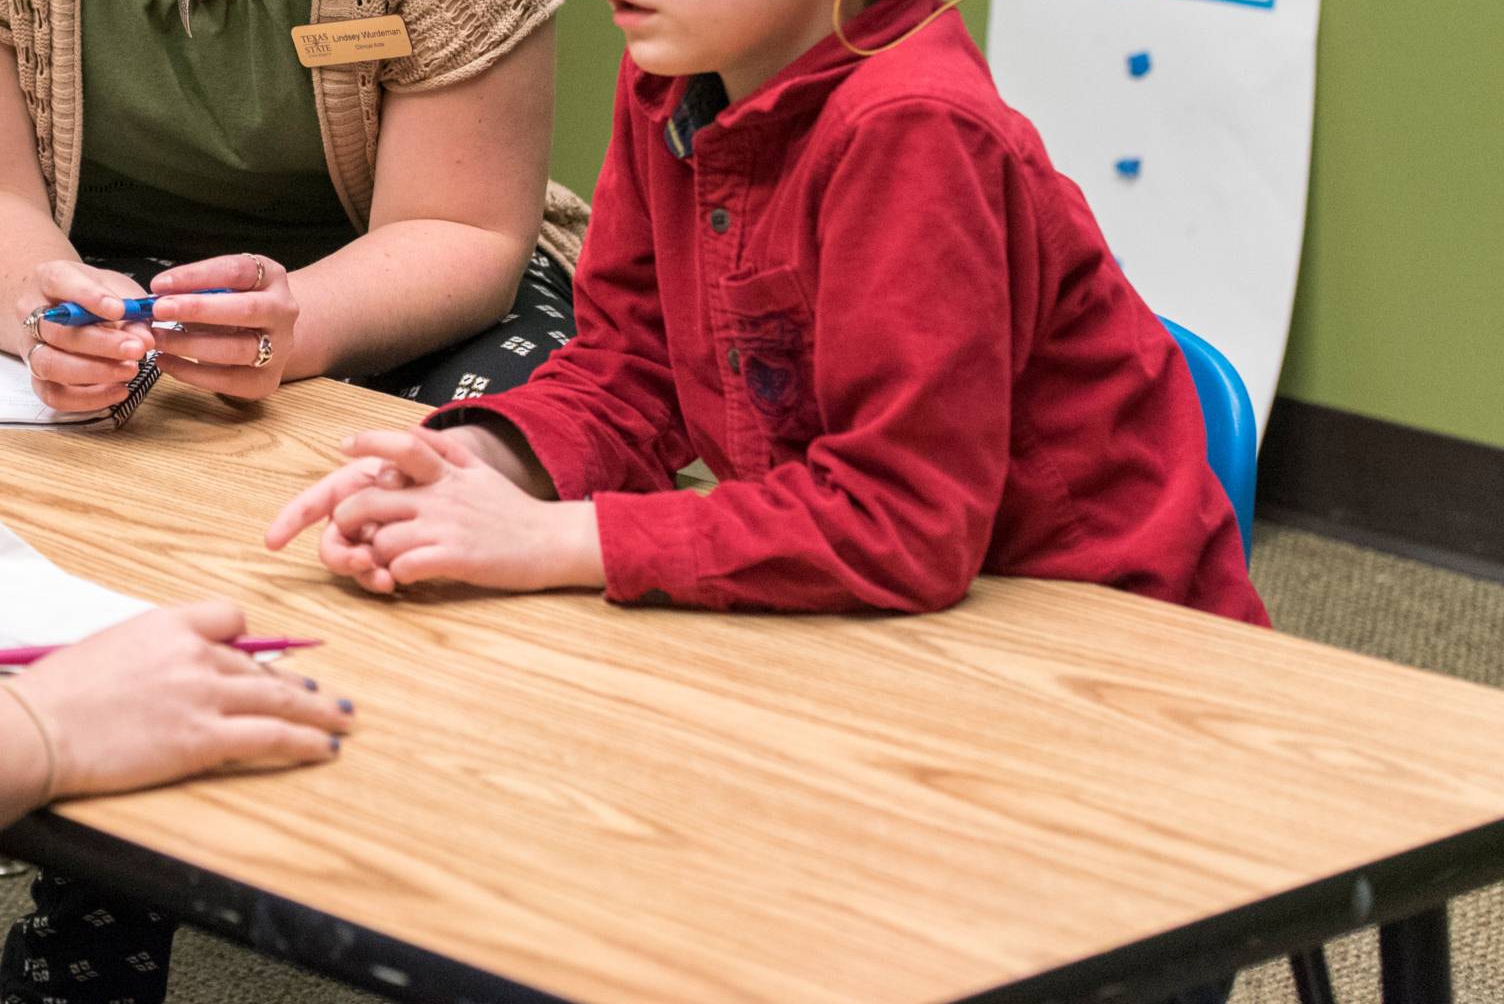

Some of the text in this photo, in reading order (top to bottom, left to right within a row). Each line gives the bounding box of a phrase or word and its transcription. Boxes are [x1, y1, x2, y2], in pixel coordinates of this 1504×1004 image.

[300, 33, 329, 44] TEXAS
[332, 32, 360, 43] Lindsey
[304, 44, 333, 53] STATE
